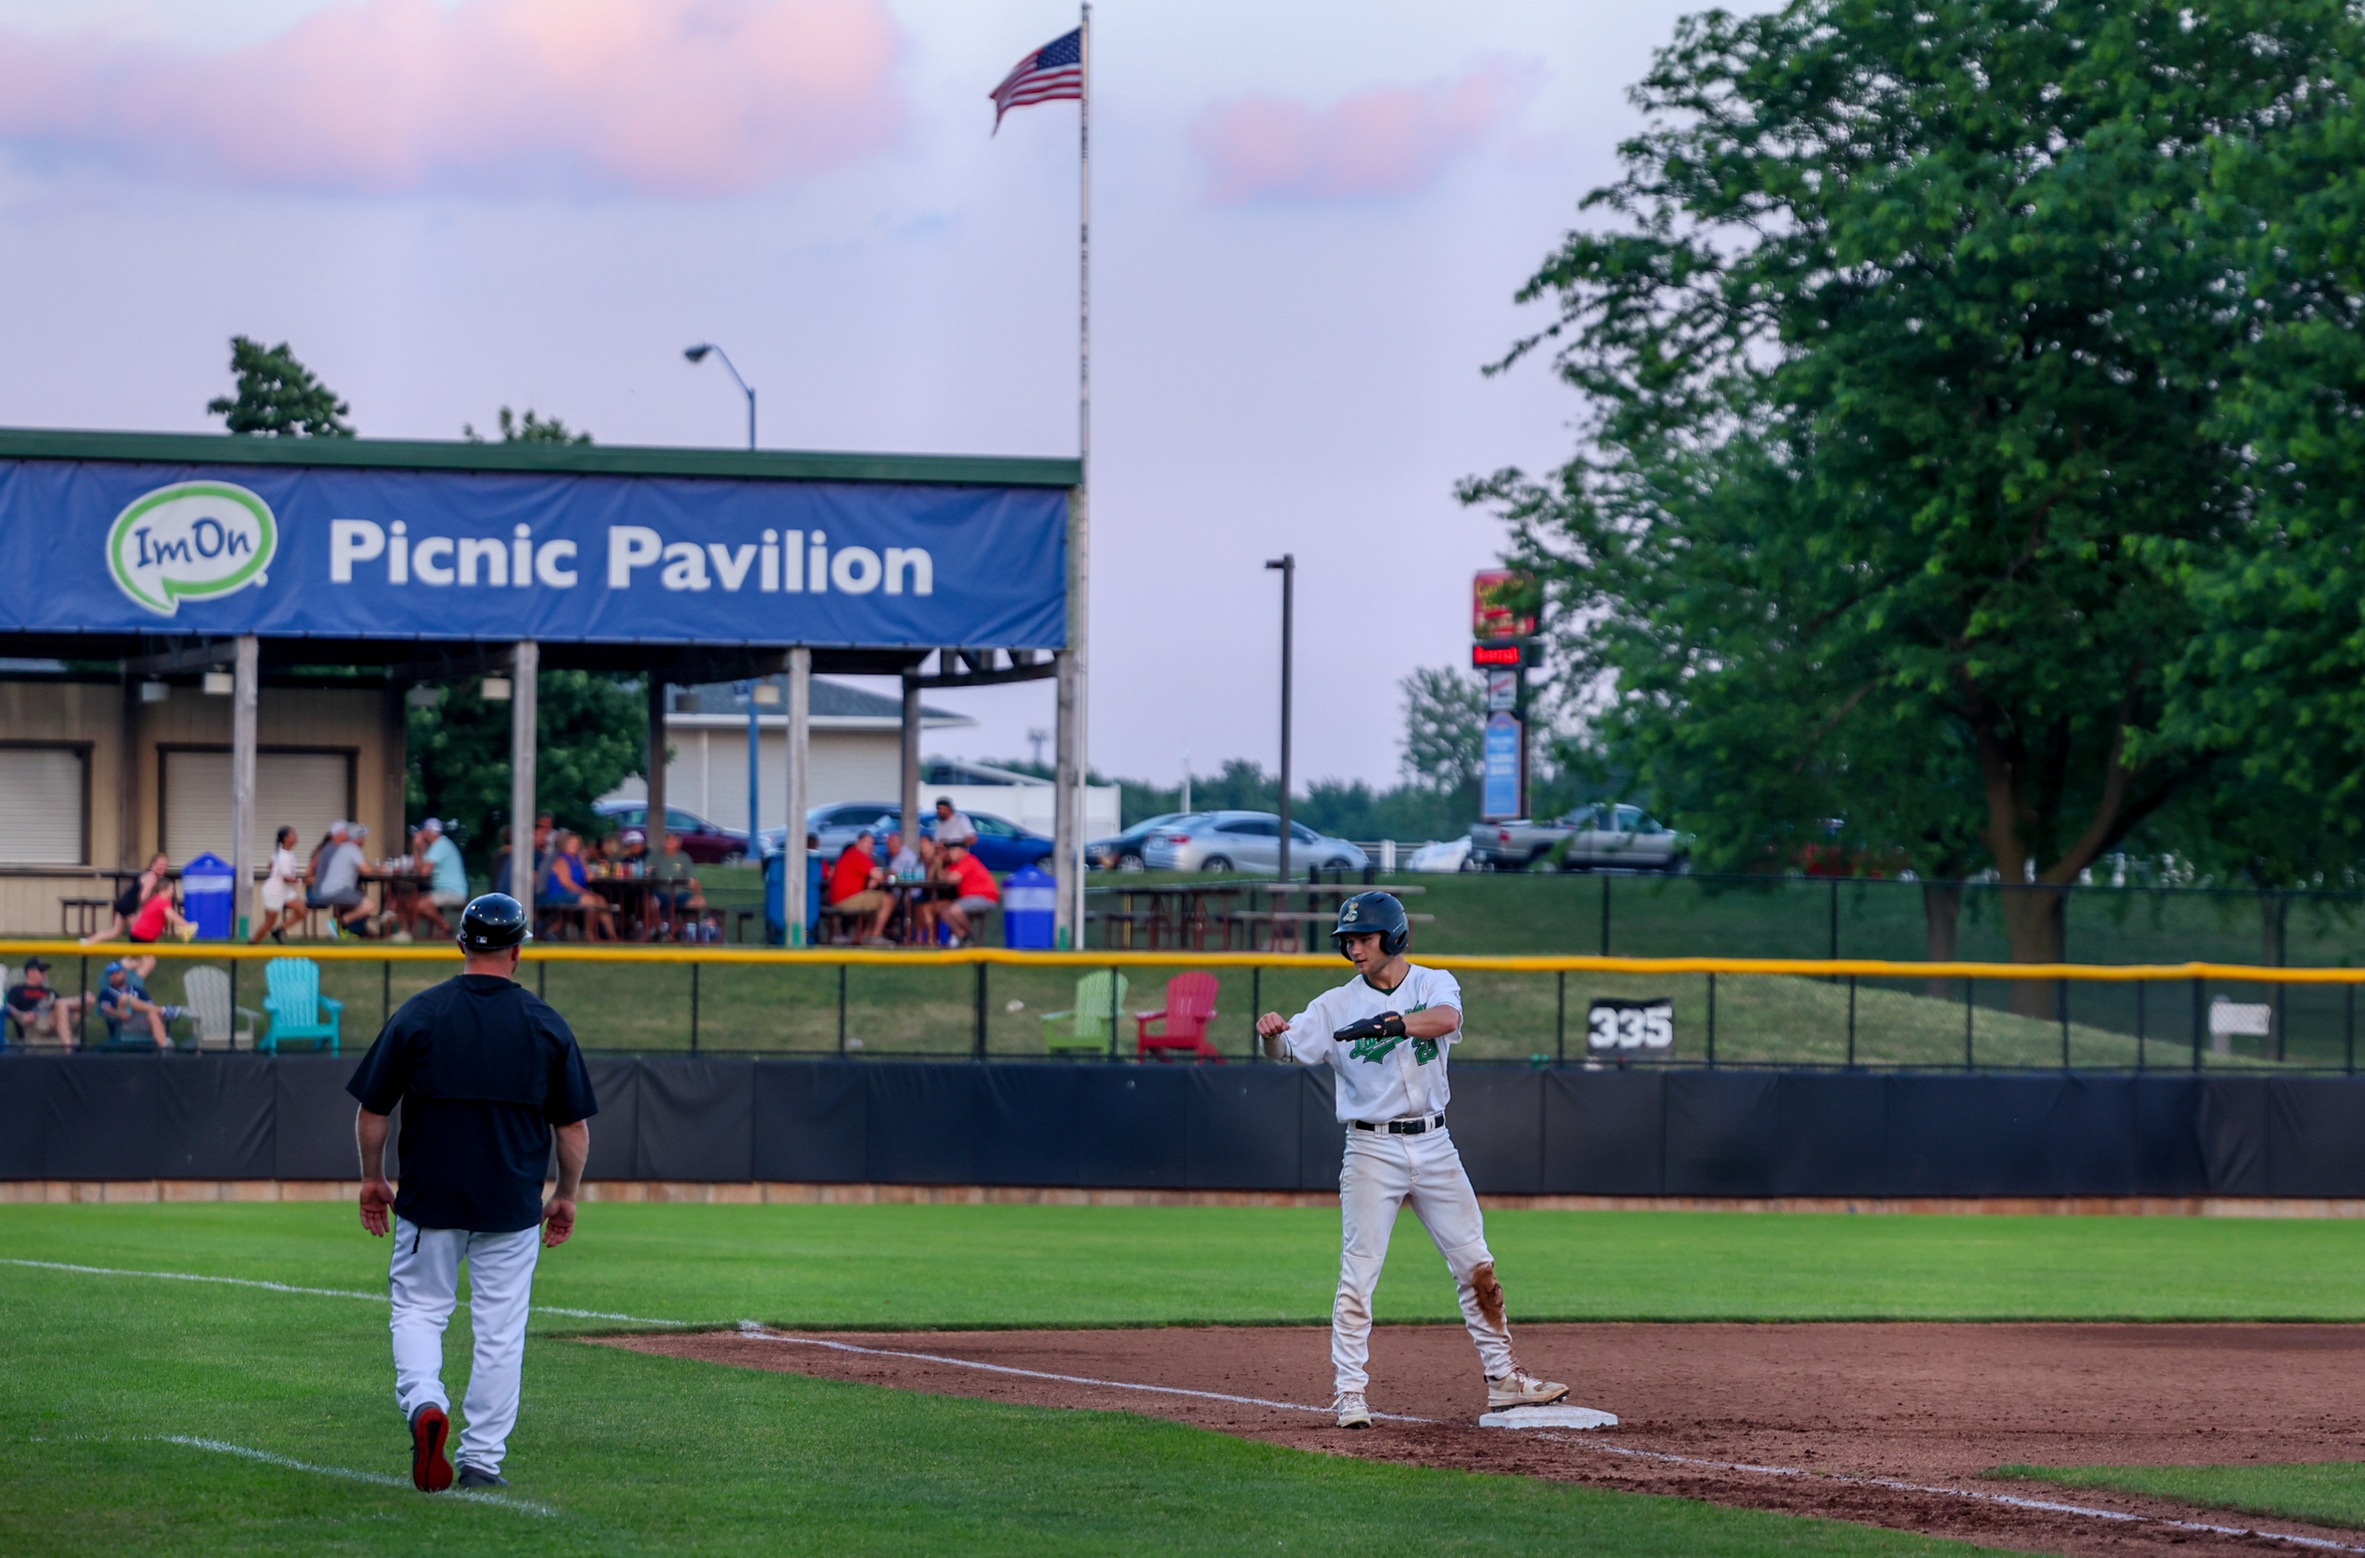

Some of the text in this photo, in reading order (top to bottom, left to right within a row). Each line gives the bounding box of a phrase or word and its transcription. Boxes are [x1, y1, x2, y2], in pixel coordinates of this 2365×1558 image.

[135, 517, 251, 568] ImOn
[330, 518, 934, 595] Picnic Pavilion
[1589, 1005, 1673, 1049] 335
